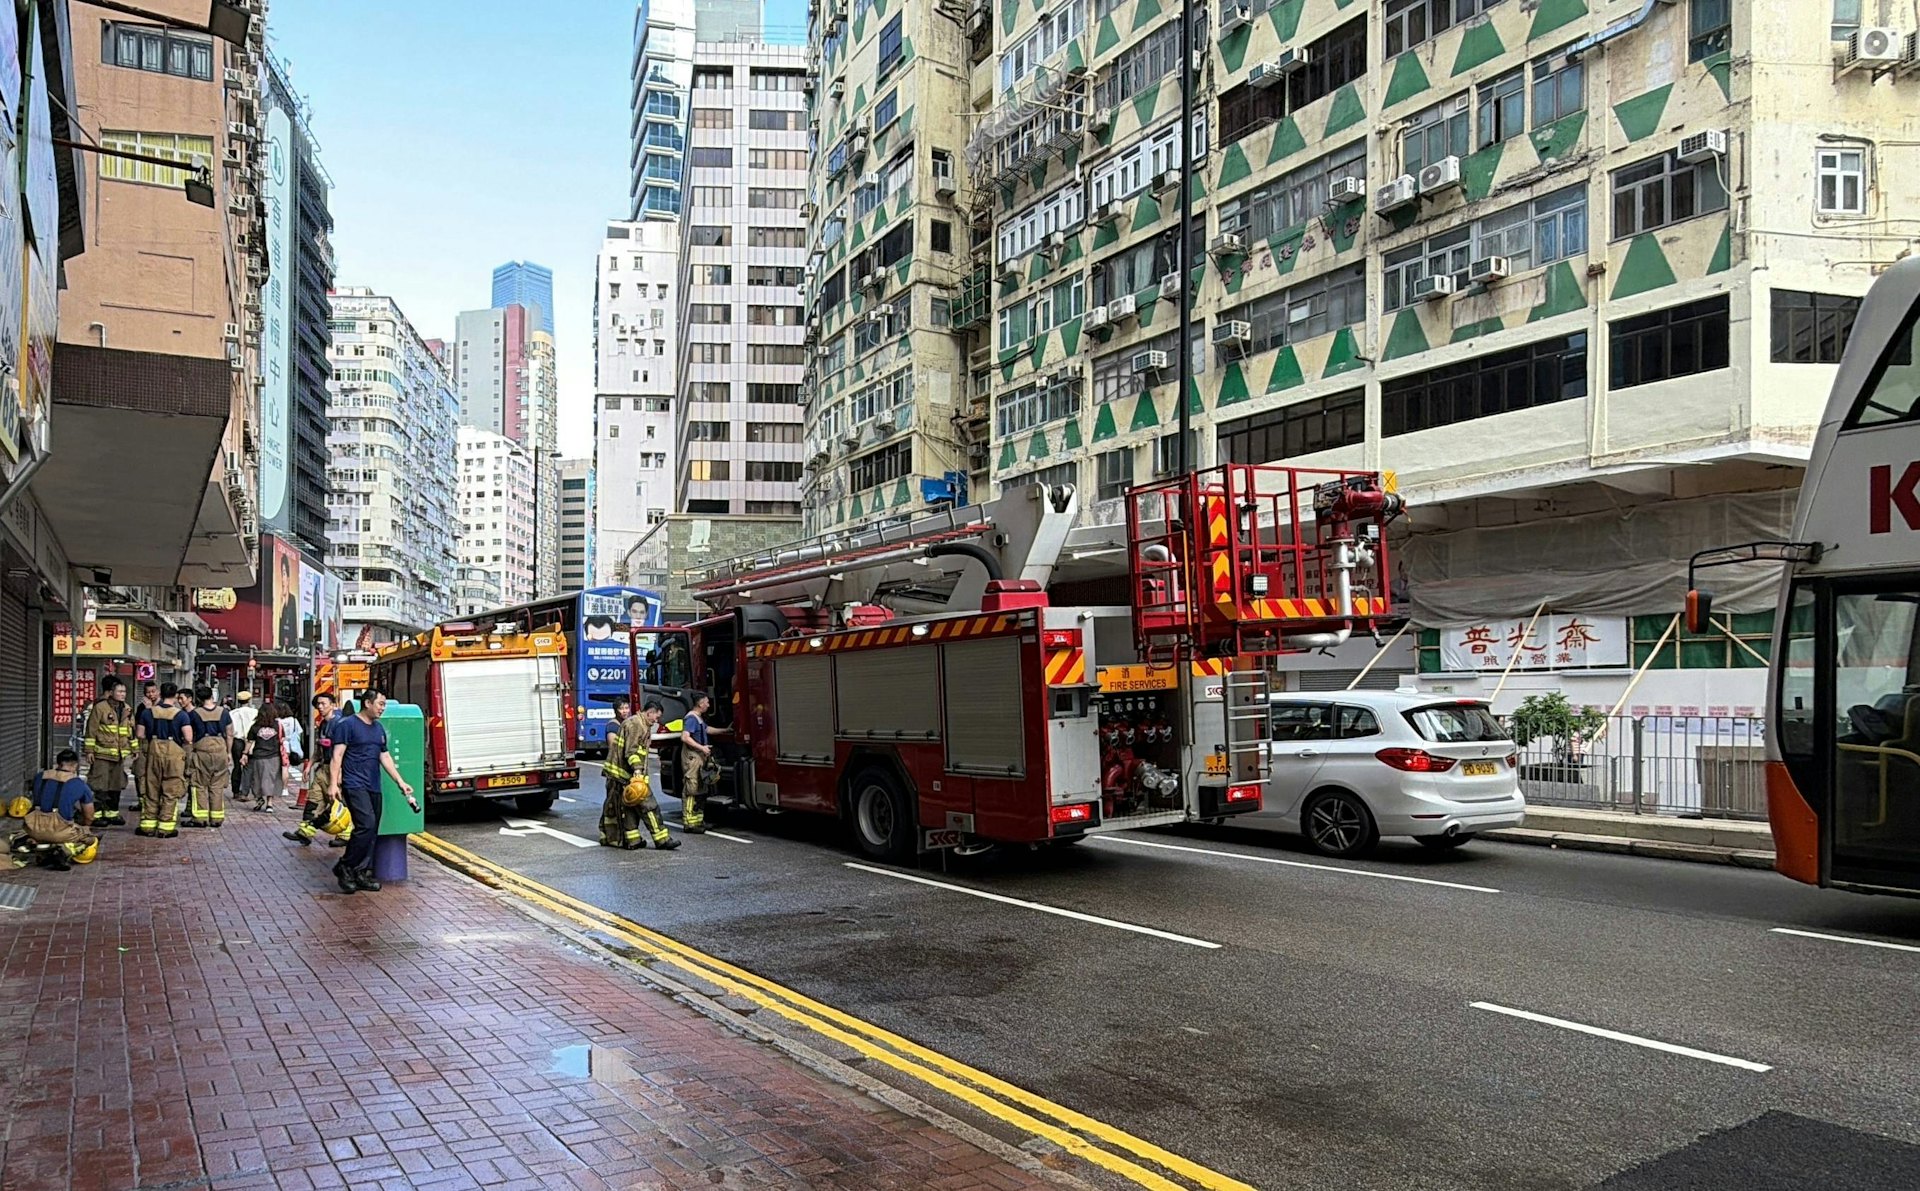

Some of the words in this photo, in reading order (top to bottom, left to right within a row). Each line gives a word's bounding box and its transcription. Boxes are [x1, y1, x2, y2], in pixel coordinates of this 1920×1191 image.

[1869, 461, 1920, 535] K
[1459, 618, 1601, 655] 普光齋
[600, 668, 626, 680] 2201
[1110, 681, 1127, 691] FIRE
[1129, 679, 1167, 690] SERVICES
[500, 776, 522, 785] 2509
